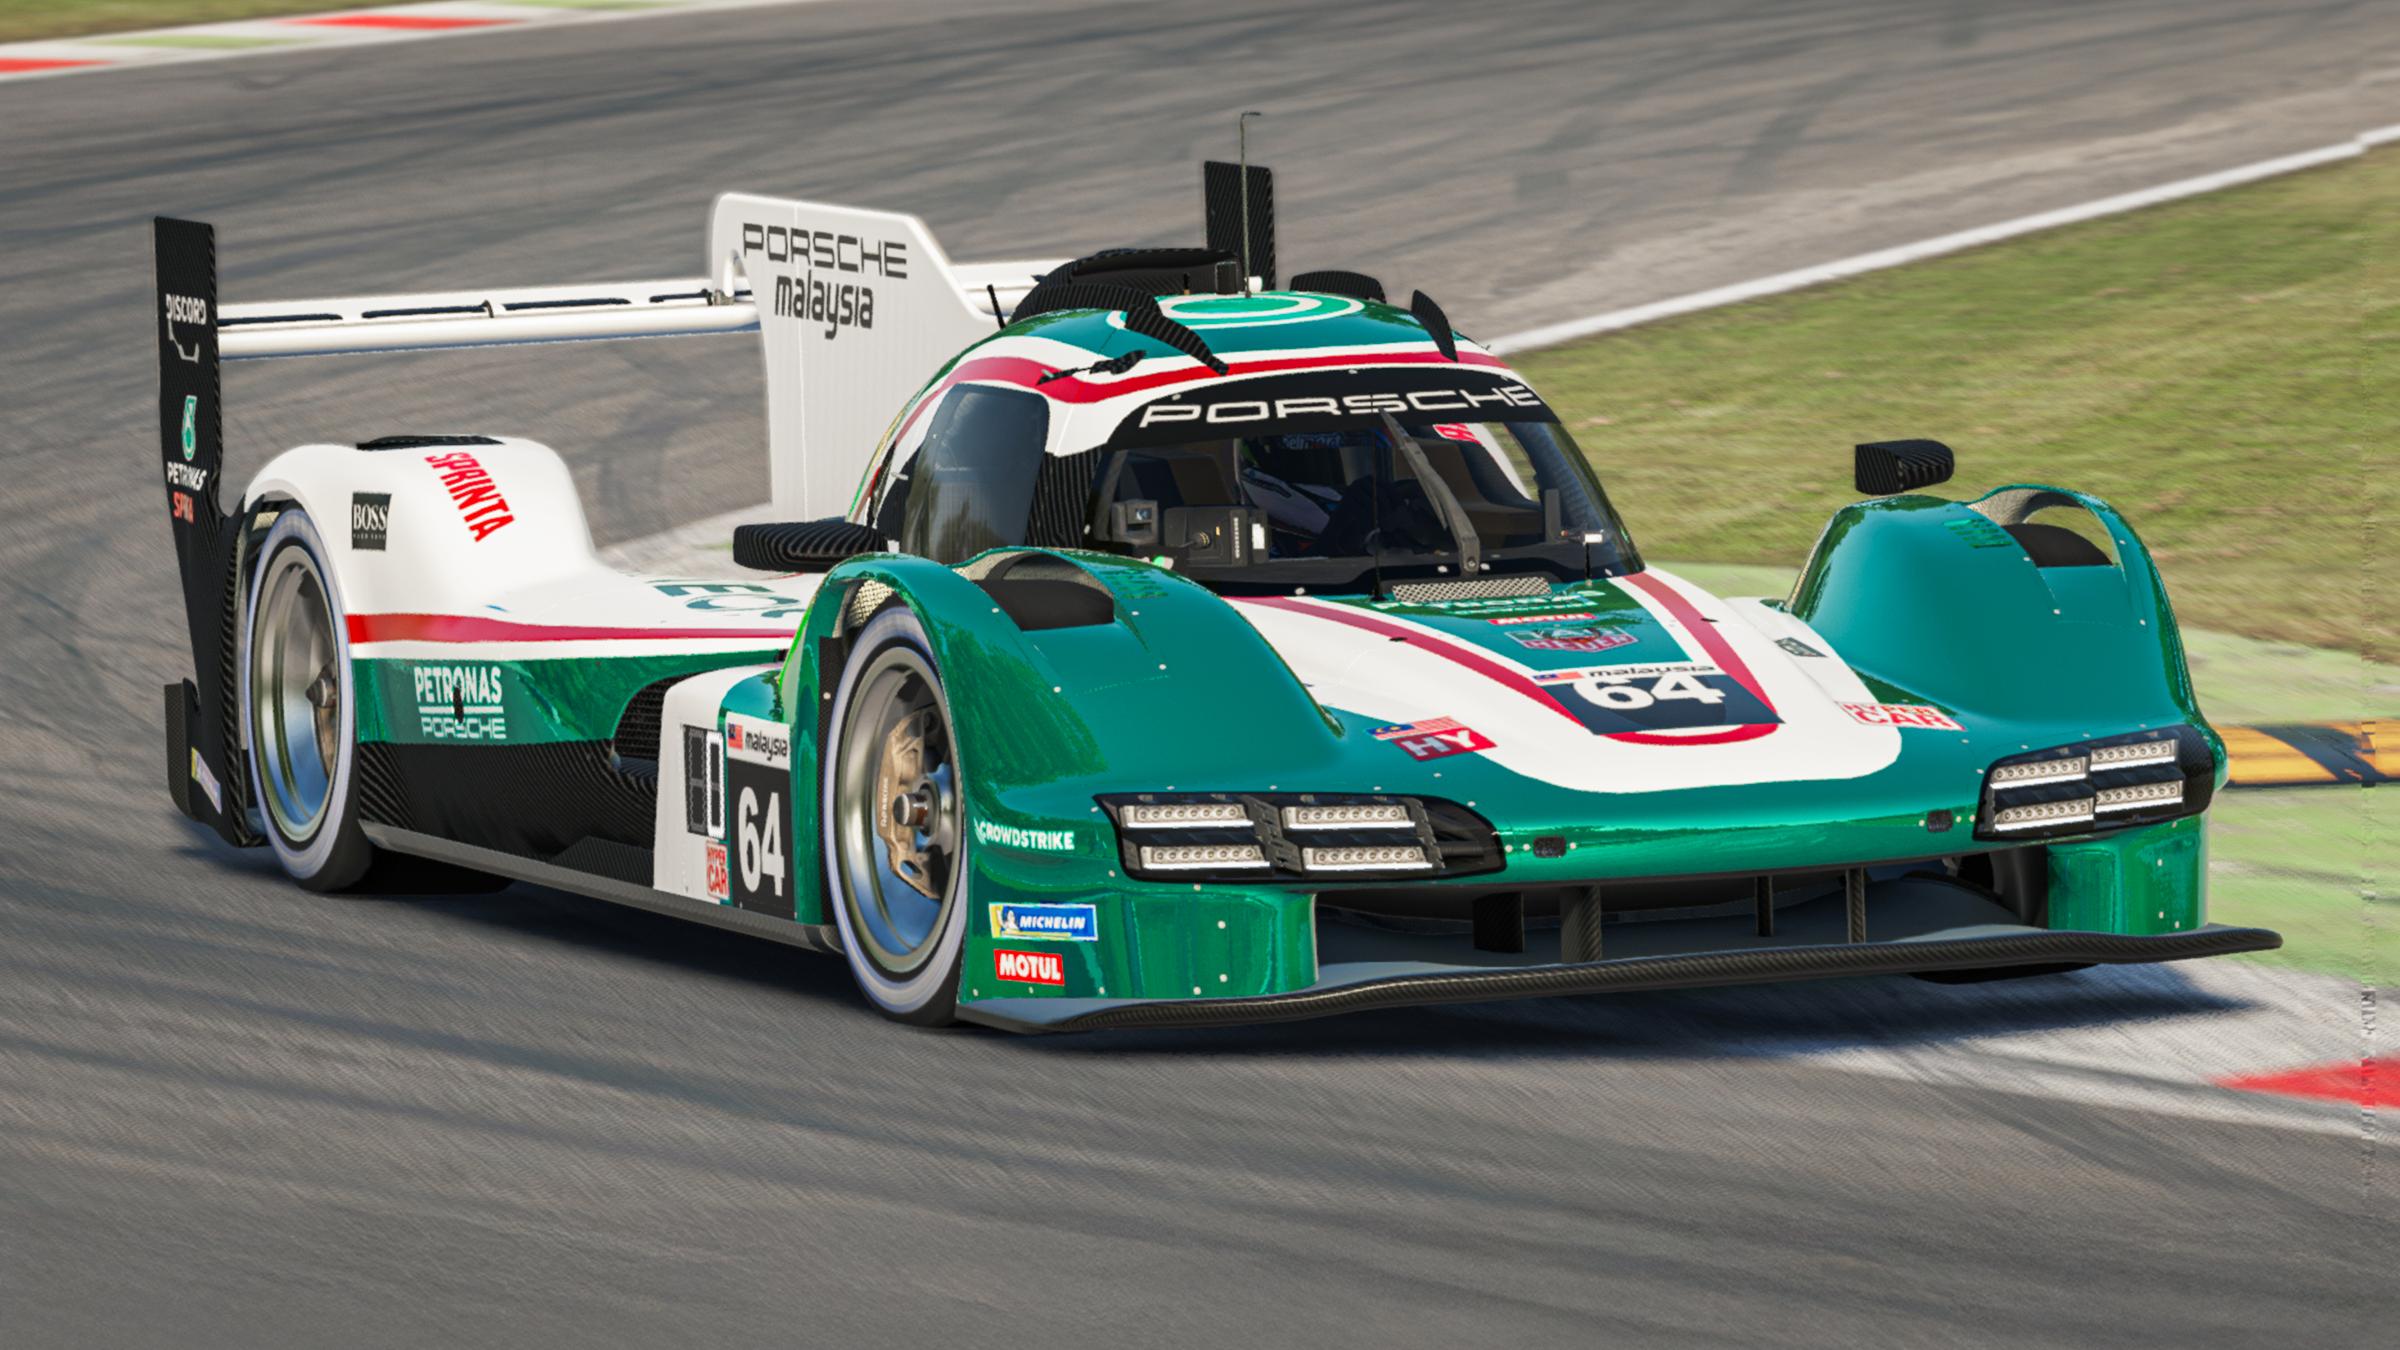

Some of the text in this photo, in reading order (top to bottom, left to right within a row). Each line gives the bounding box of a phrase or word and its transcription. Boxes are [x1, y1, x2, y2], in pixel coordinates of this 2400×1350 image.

[743, 222, 908, 280] PORSCHE
[165, 293, 207, 326] DISCORD
[775, 269, 873, 340] malaysia
[1138, 385, 1542, 428] PORSCHE
[424, 451, 515, 543] SPRINTA
[353, 503, 388, 531] BOSS
[413, 665, 503, 704] PETRONAS
[1589, 664, 1716, 680] malaysia
[1573, 674, 1727, 710] 64
[420, 716, 507, 740] PORSCHE
[1854, 710, 1954, 728] CAR
[745, 731, 788, 762] malaysia
[1401, 729, 1477, 757] HY
[737, 785, 786, 897] 64
[979, 820, 1076, 851] CROWDSTRIKE
[706, 845, 728, 866] HYPER
[707, 863, 730, 893] CAR
[1019, 915, 1087, 930] MICHELIN
[999, 953, 1062, 981] MOTUL
